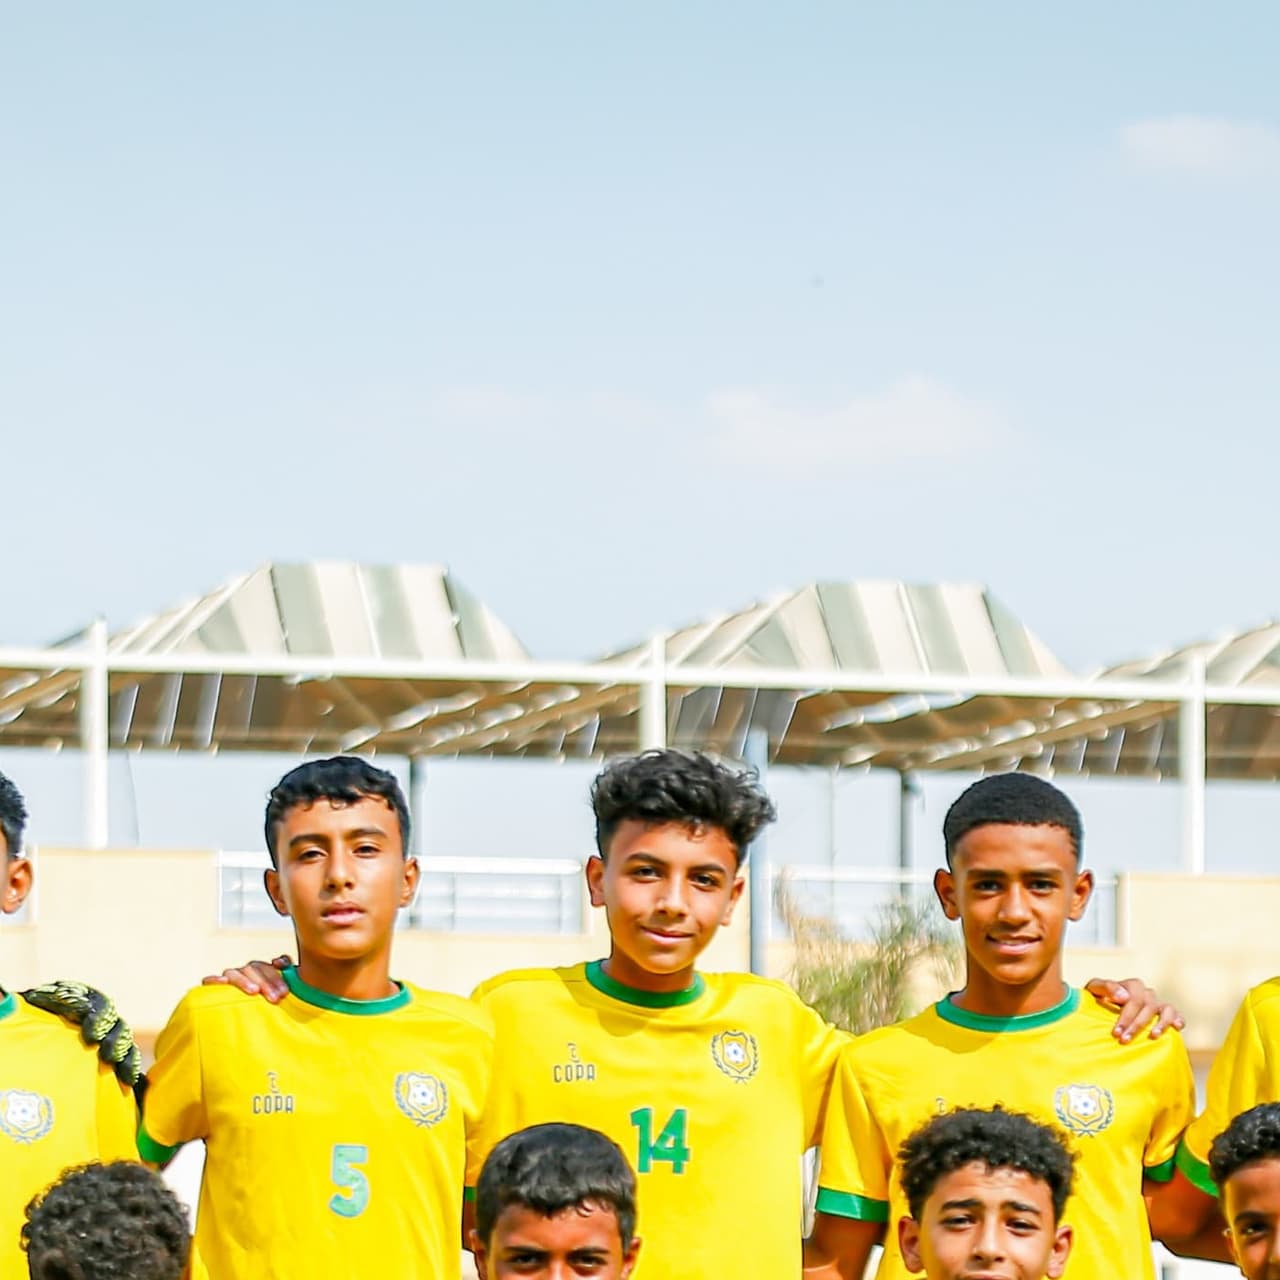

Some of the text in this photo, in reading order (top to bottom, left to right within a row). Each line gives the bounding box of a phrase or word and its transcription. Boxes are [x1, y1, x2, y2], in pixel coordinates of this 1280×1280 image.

[552, 1063, 596, 1083] COPA
[252, 1095, 293, 1114] COPA
[630, 1107, 690, 1174] 14
[329, 1144, 369, 1217] 5
